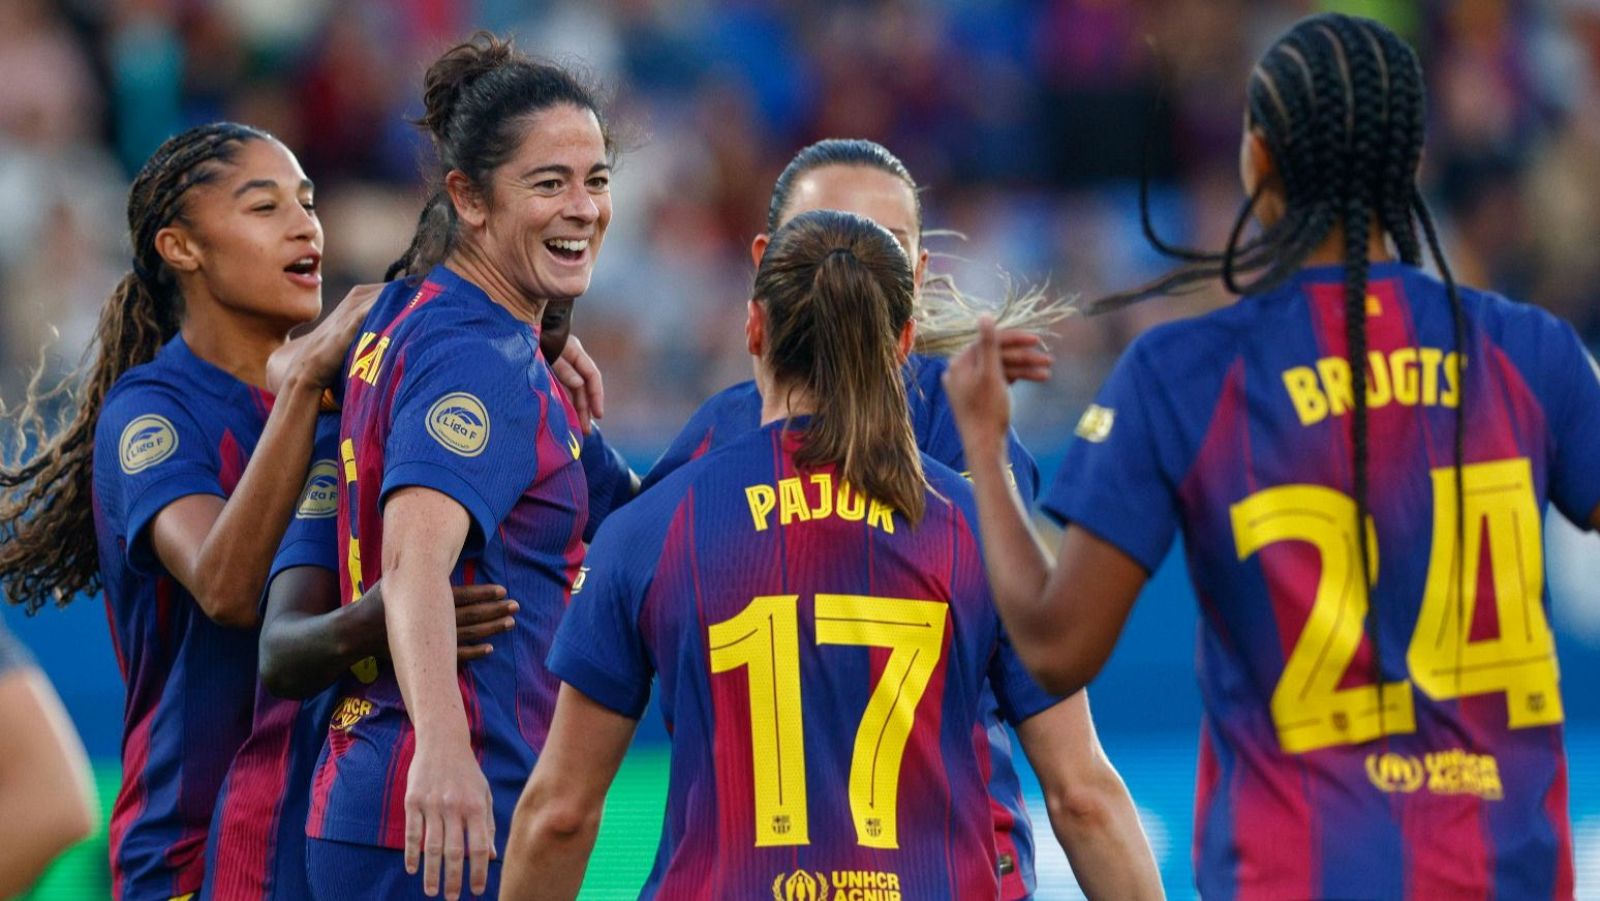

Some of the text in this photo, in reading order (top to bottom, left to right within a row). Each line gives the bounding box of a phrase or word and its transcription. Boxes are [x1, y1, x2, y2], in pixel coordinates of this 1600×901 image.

[442, 416, 468, 437] Liga
[469, 430, 478, 440] F
[1229, 458, 1563, 754] 24
[708, 594, 949, 849] 17
[831, 870, 900, 890] UNHCR
[832, 888, 902, 901] ACNUR
